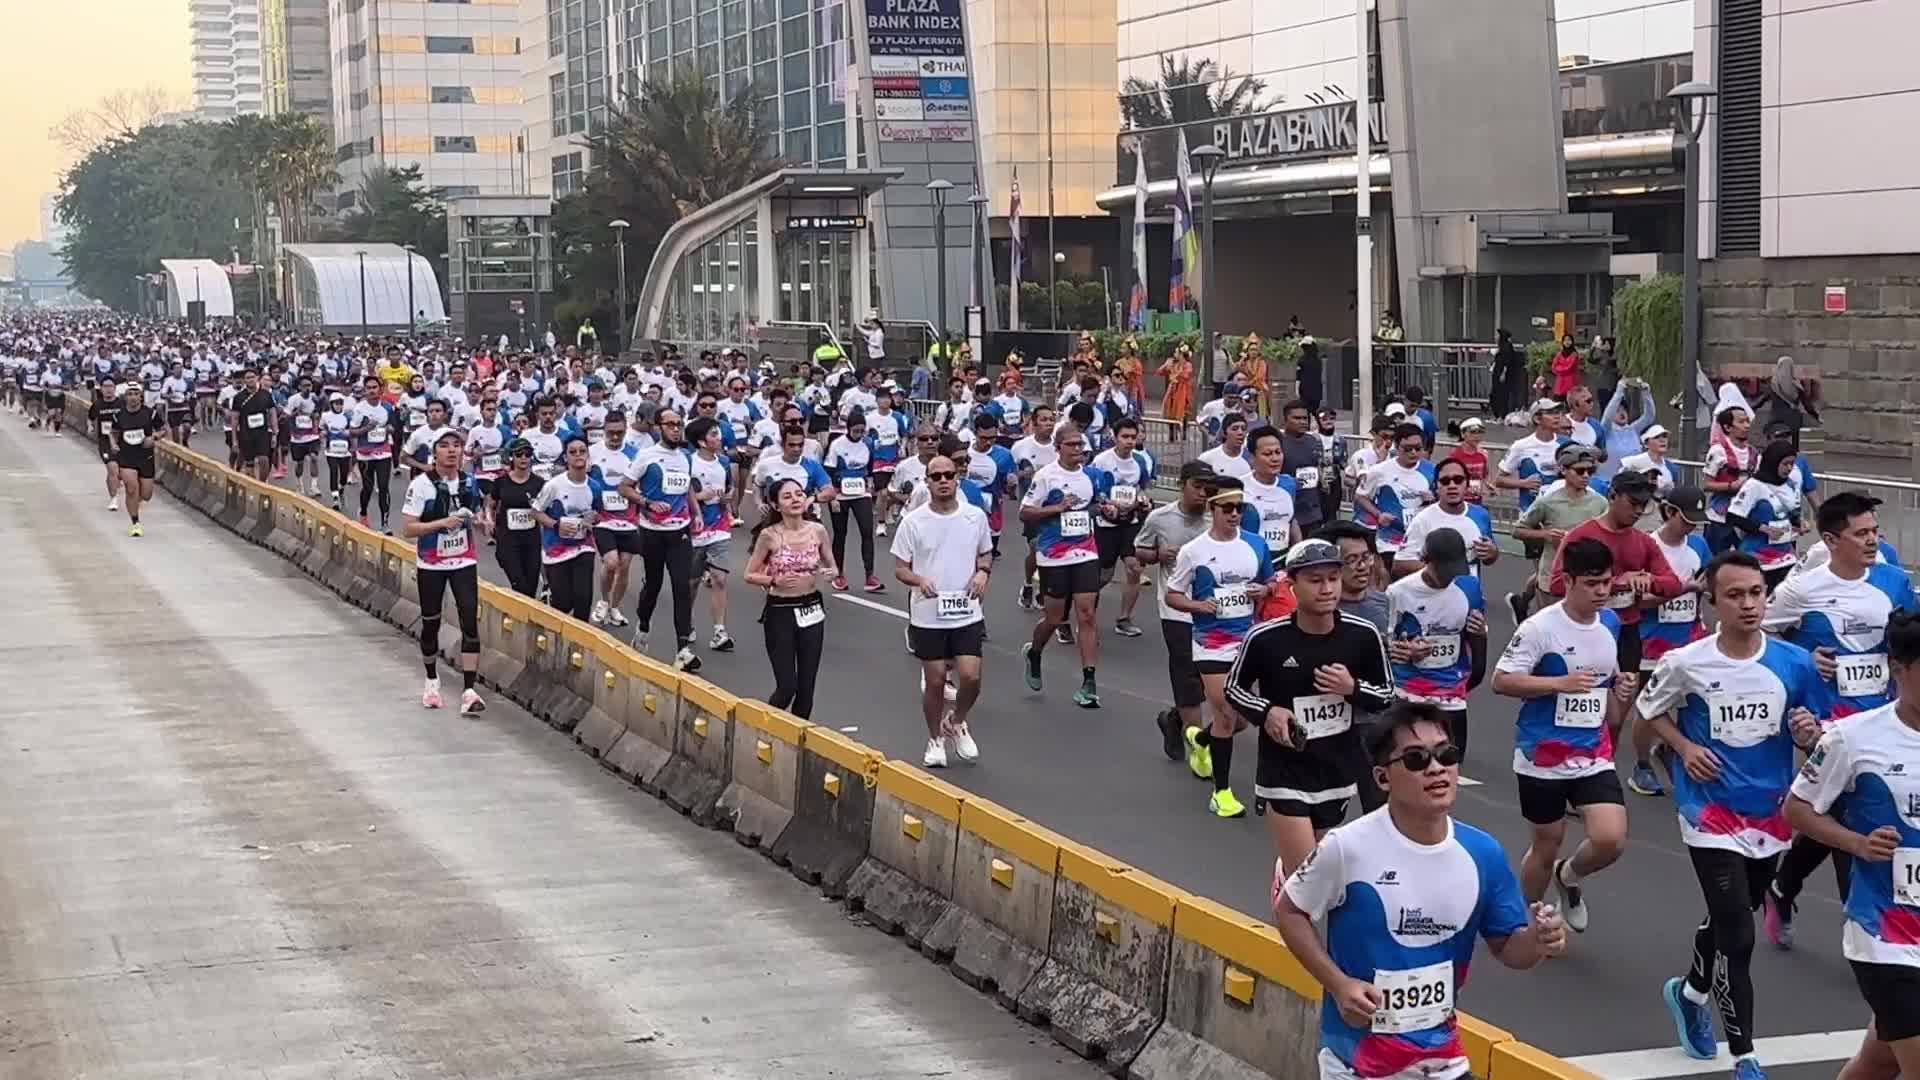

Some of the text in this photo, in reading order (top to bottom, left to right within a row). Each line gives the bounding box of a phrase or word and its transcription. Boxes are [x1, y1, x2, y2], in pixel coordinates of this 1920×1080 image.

[887, 0, 940, 12] PLAZA
[869, 16, 960, 29] BANK INDEX
[886, 37, 917, 45] PLAZA
[919, 37, 963, 45] PERMATA
[937, 62, 967, 72] THAI
[1213, 115, 1282, 158] PLAZA
[1286, 104, 1356, 153] BANK
[943, 598, 969, 609] 17166
[1663, 599, 1695, 611] 14230
[1429, 643, 1456, 658] 633
[1845, 664, 1882, 680] 11730
[1303, 701, 1345, 724] 11437
[1564, 697, 1601, 713] 12619
[1719, 703, 1769, 723] 11473
[1381, 980, 1446, 1011] 13928
